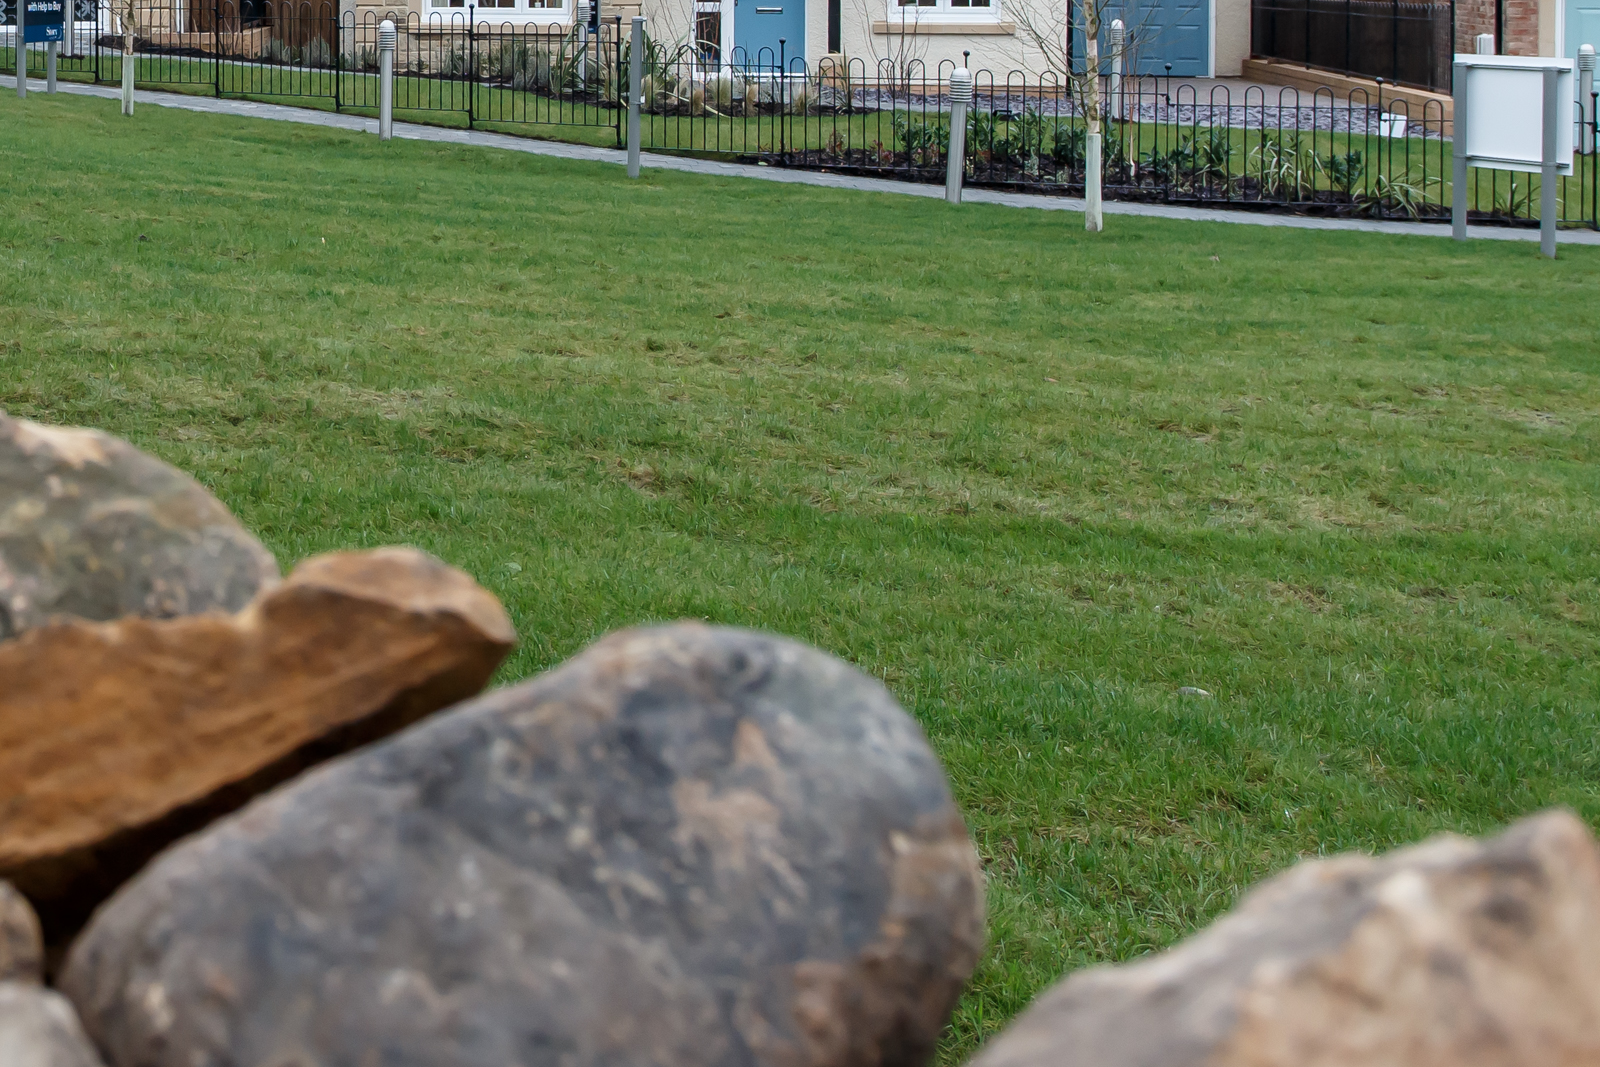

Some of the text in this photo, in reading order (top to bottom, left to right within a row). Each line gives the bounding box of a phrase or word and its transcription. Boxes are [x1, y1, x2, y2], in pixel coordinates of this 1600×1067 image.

[27, 1, 61, 12] with Help to Buy
